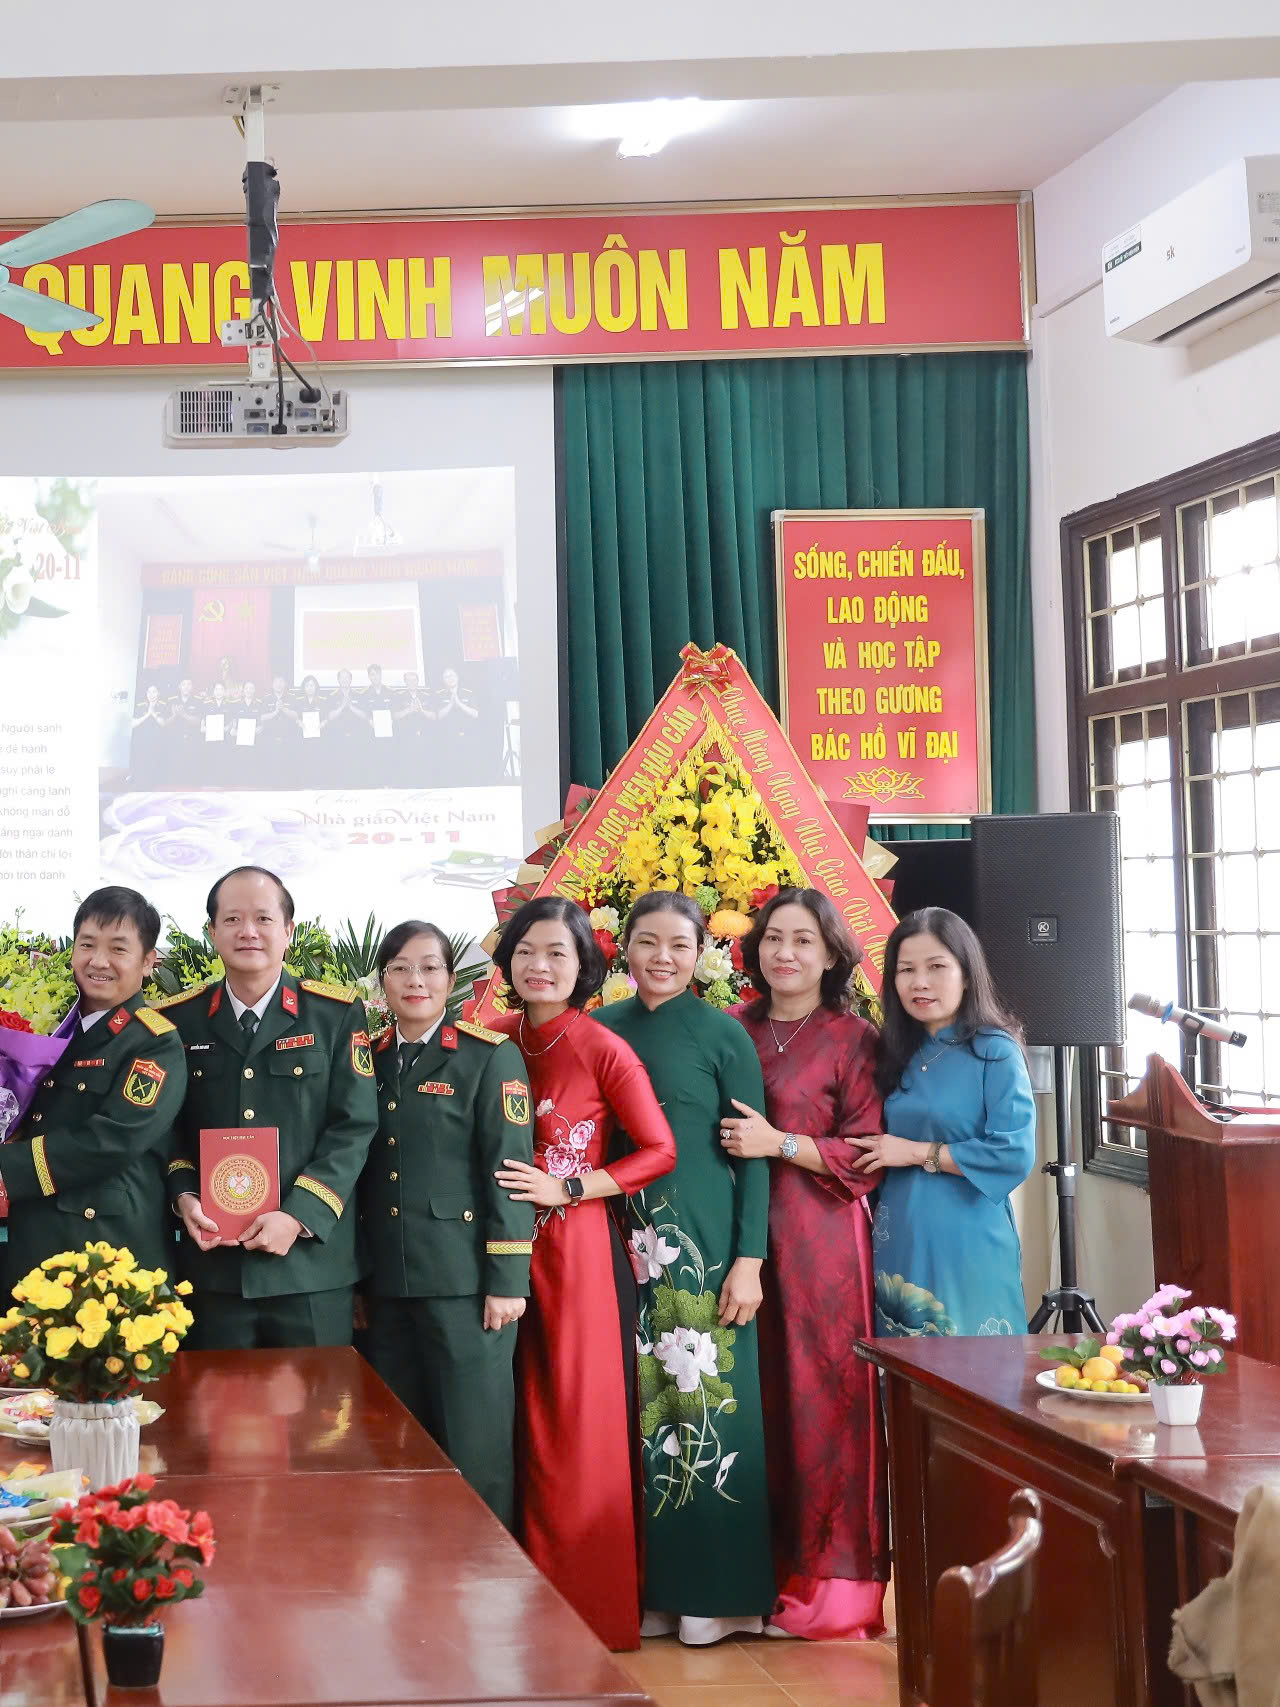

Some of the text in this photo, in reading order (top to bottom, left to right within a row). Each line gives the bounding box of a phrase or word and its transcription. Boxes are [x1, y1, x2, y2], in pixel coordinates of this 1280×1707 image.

[290, 255, 451, 341] VINH
[482, 234, 689, 337] MUÔN
[717, 230, 886, 330] NĂM
[35, 552, 81, 581] 20-11
[793, 540, 965, 581] SỐNG, CHIẾN ĐẤU,
[827, 590, 929, 629] LAO ĐỘNG
[823, 635, 941, 674] VÀ HỌC TẬP
[816, 683, 943, 715] THEO GƯƠNG
[661, 705, 699, 744] CẦN
[811, 722, 959, 764] BÁC HỒ VĨ ĐẠI
[447, 809, 497, 823] Nam
[718, 687, 749, 728] Chúc
[738, 729, 774, 774] Mừng
[767, 771, 801, 820] Ngày
[794, 817, 828, 859] Nhà
[811, 858, 849, 898] Giáo
[842, 897, 877, 936] Việt
[347, 829, 461, 845] 20-11
